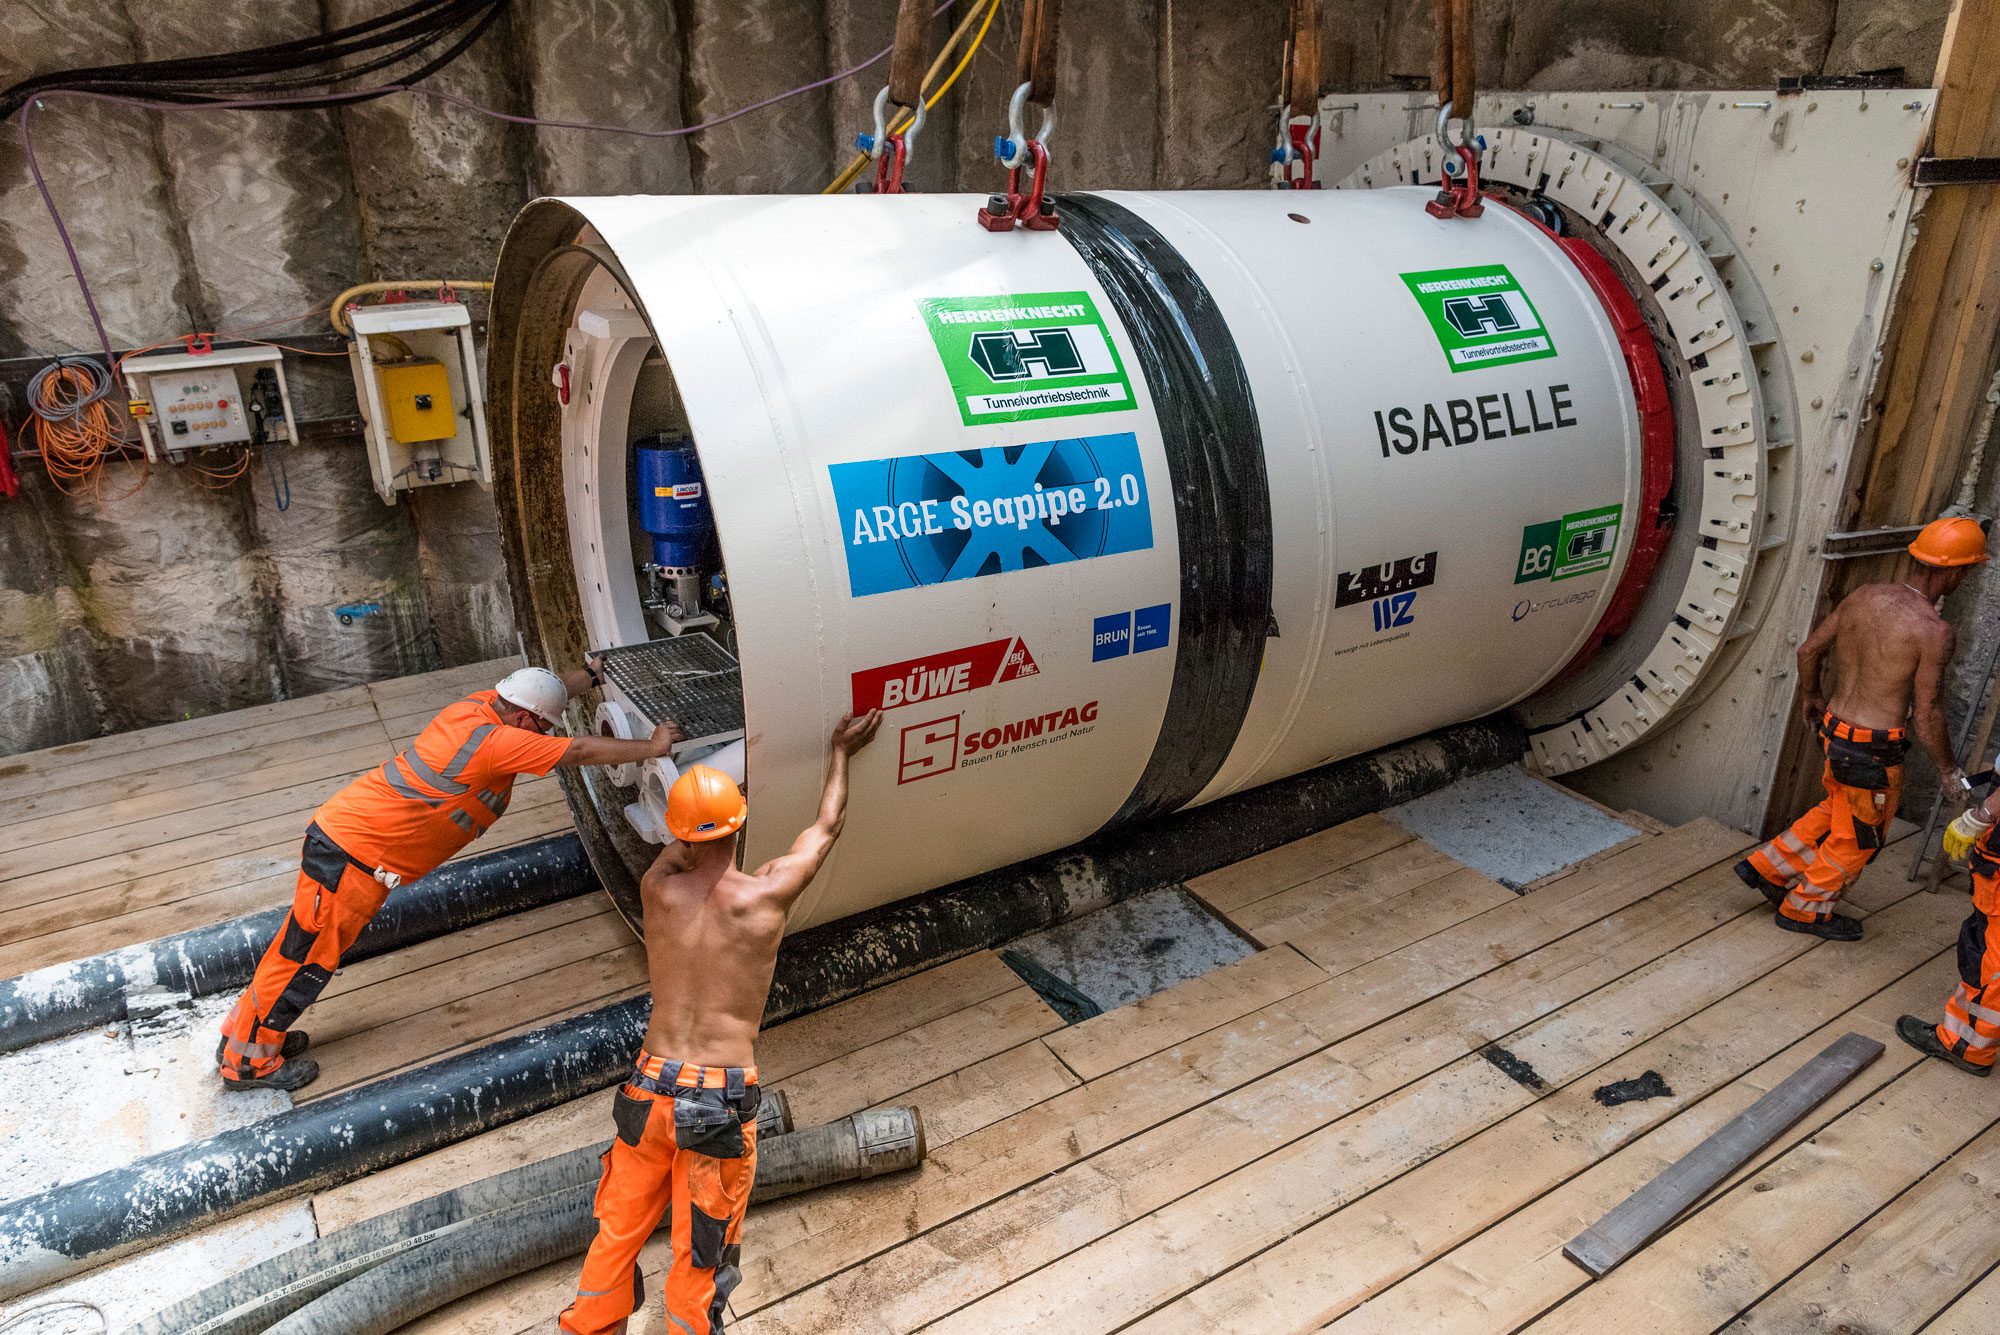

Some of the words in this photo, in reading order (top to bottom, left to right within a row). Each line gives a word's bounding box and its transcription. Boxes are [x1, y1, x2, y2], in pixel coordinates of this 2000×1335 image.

[1417, 274, 1510, 294] HERRENKNECHT
[939, 304, 1085, 325] HERRENKNECHT
[1461, 340, 1539, 361] Tunnelvortriebstechnik
[983, 387, 1110, 409] Tunnelvortriebstechnik
[1374, 383, 1578, 458] ISABELLE
[852, 499, 943, 546] ARGE
[951, 482, 1087, 530] Seapipe
[1094, 474, 1140, 511] 2.0
[1566, 513, 1618, 531] HERRENKNECHT
[1522, 545, 1552, 576] BG
[1096, 629, 1128, 645] BRUN
[881, 662, 971, 709] BÜWE
[963, 701, 1098, 756] SONNTAG
[961, 755, 993, 768] Bauen
[995, 749, 1009, 759] für
[1011, 738, 1047, 755] Mensch
[1050, 732, 1067, 744] und
[1069, 725, 1095, 738] Natur
[264, 1287, 289, 1303] A.S.T.
[291, 1274, 324, 1291] Bochum
[325, 1267, 337, 1278] DN
[382, 1246, 395, 1256] bar
[401, 1239, 412, 1249] PD
[414, 1236, 423, 1244] 48
[424, 1232, 437, 1240] bar
[211, 1317, 225, 1328] bar
